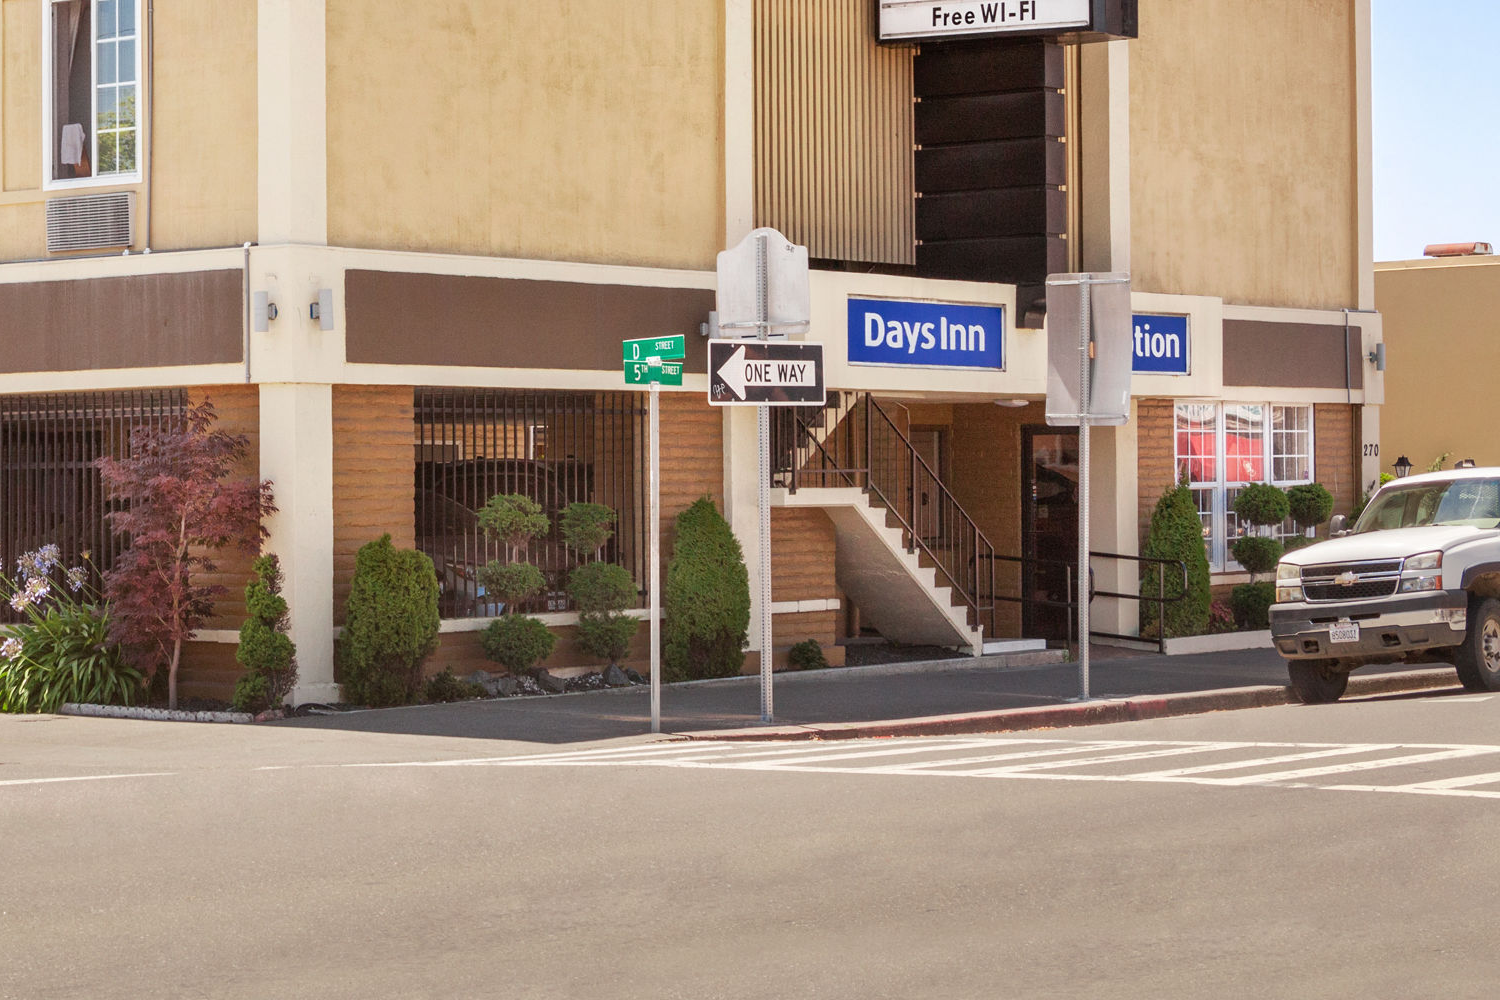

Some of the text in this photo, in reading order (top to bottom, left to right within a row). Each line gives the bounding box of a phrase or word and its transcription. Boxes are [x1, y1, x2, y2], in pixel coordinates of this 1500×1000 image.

[932, 0, 1036, 27] Free WI-FI
[864, 312, 986, 354] Days Inn
[1132, 323, 1180, 358] tion
[632, 340, 674, 360] D STREET
[661, 365, 680, 375] STREET
[745, 363, 806, 383] ONE WAY
[1363, 443, 1379, 457] 270
